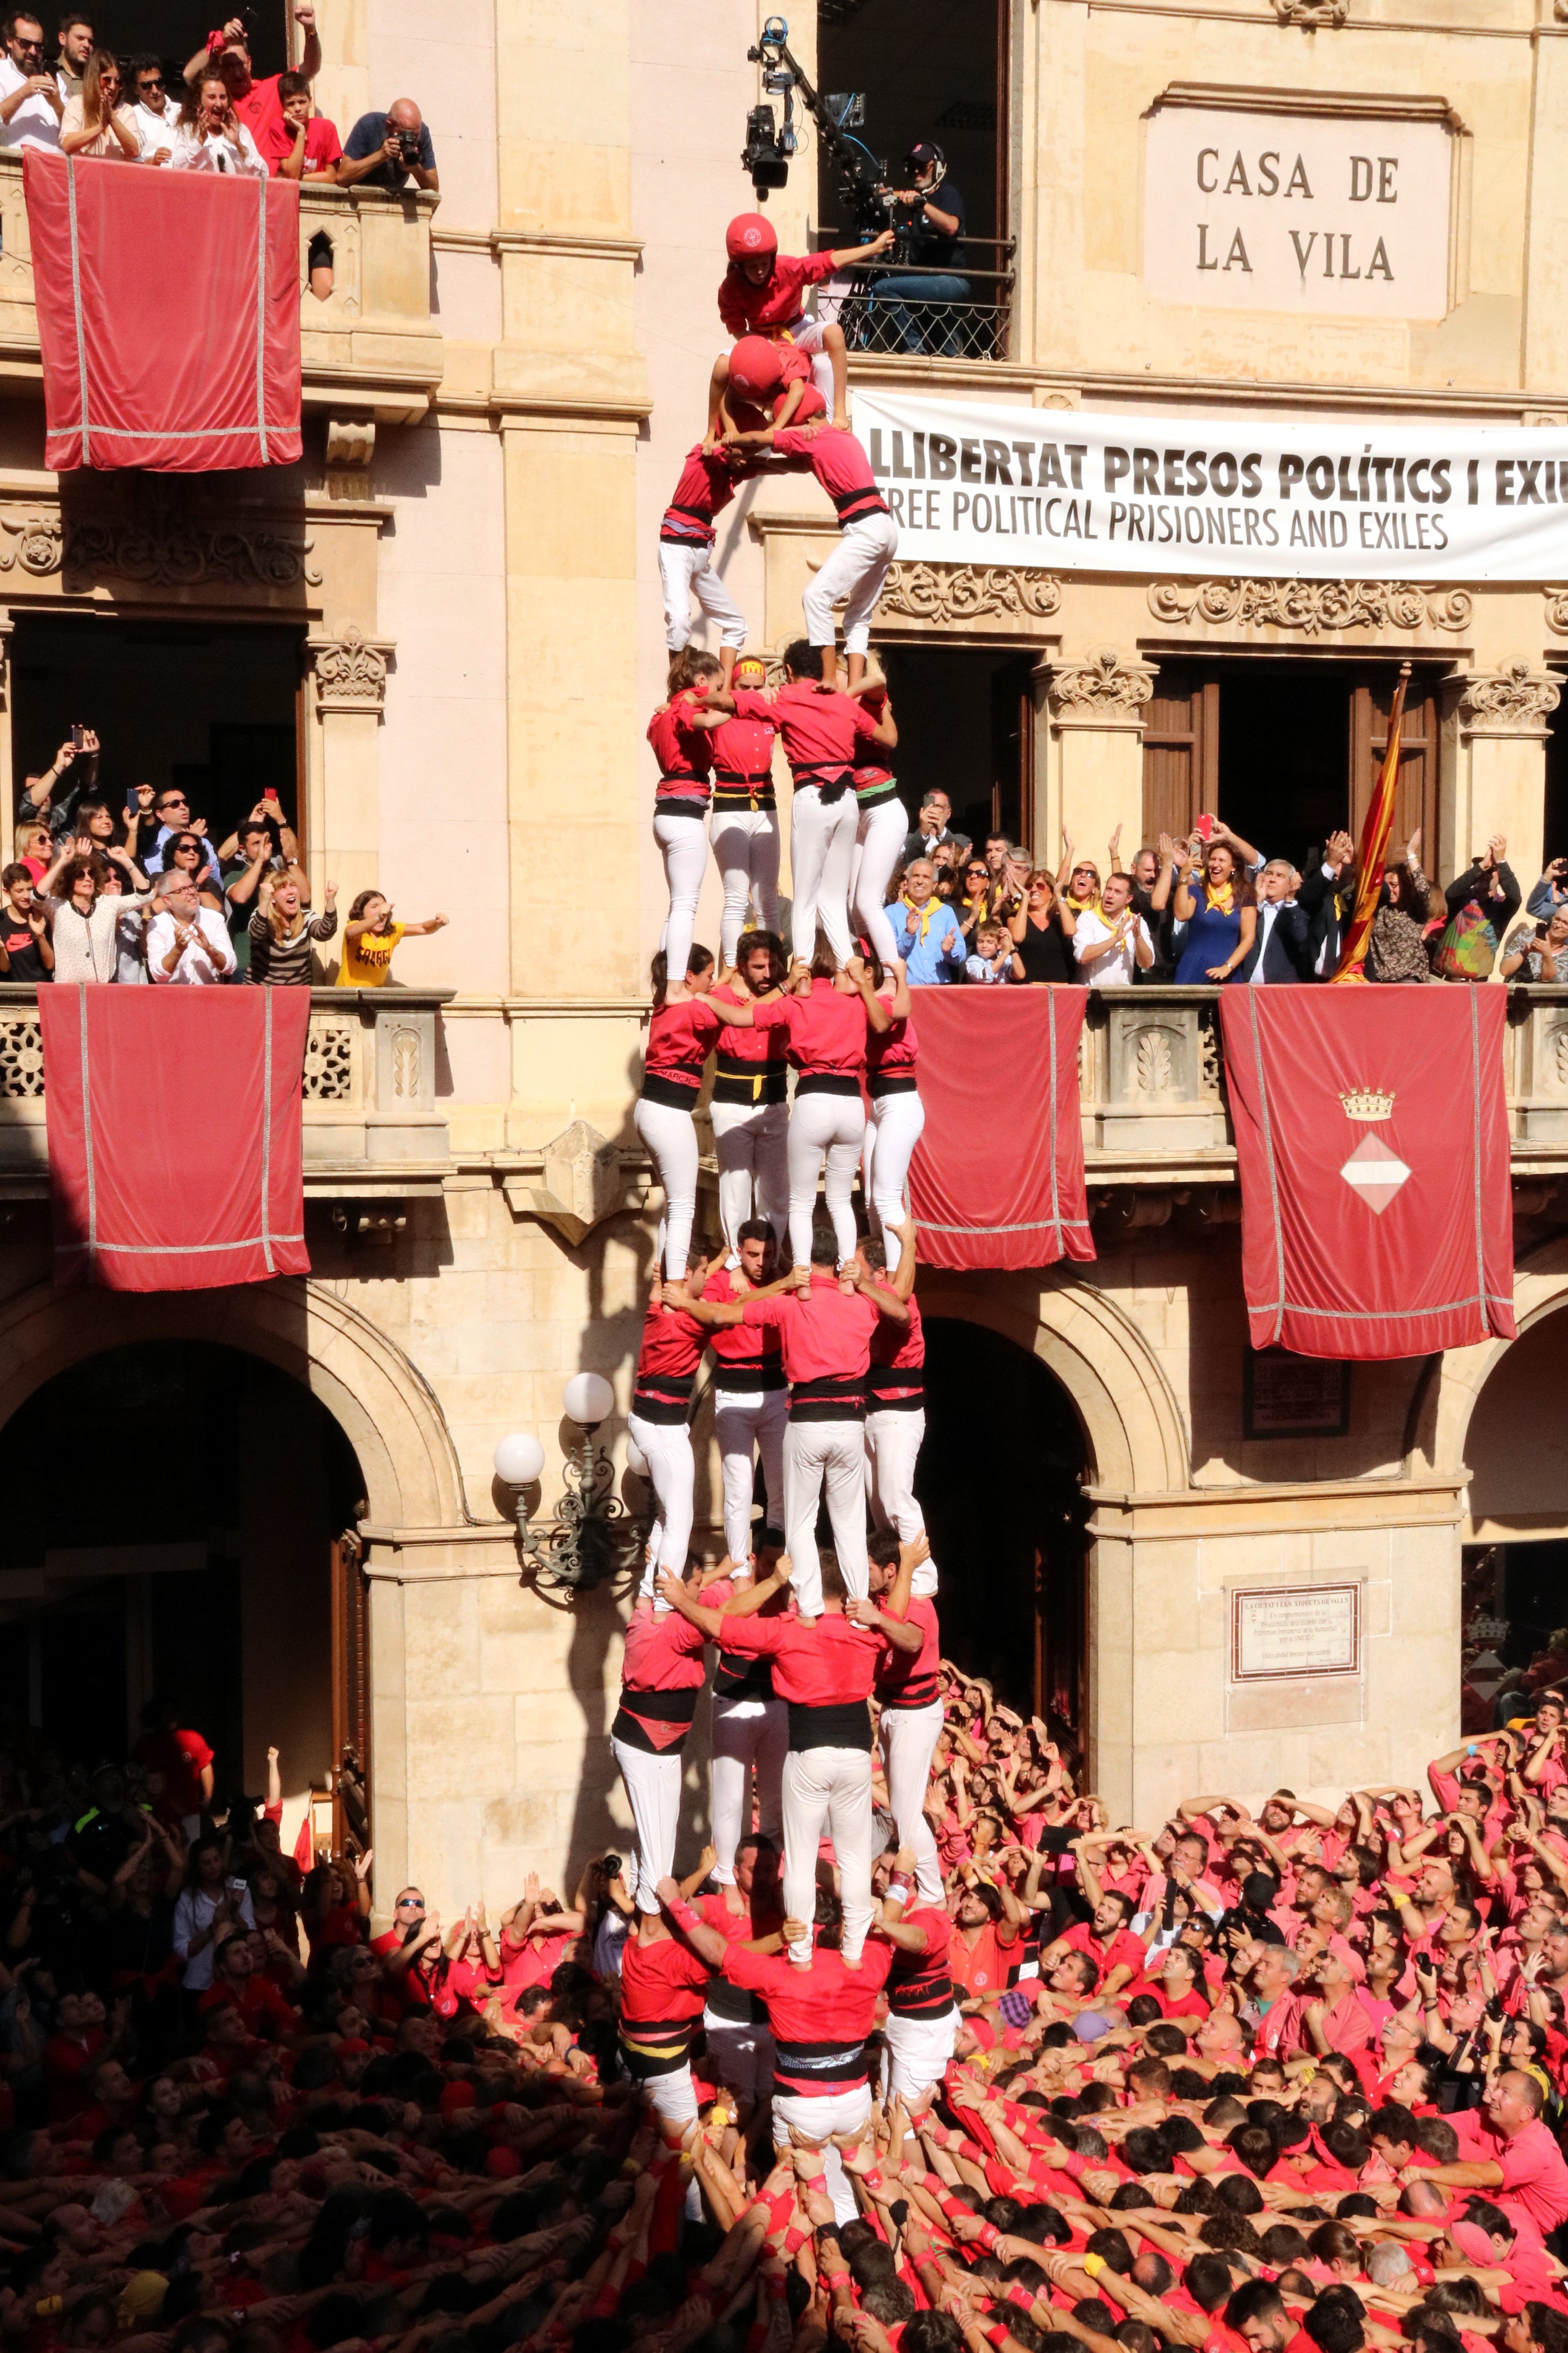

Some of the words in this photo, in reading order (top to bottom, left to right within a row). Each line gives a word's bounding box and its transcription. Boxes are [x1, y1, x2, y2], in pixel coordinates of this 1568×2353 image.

[1197, 147, 1314, 199] CASA
[1349, 155, 1399, 203] DE
[1197, 223, 1253, 272] LA
[1288, 230, 1395, 281] VILA
[870, 428, 1088, 490] LLIBERTAT
[1104, 445, 1263, 499] PRESOS
[1278, 443, 1452, 504] POLÍTICS
[1467, 459, 1479, 505] I
[953, 490, 1098, 540] POLITICAL
[1109, 501, 1279, 547] PRISIONERS
[1289, 509, 1348, 548] AND
[1360, 511, 1448, 551] EXILES
